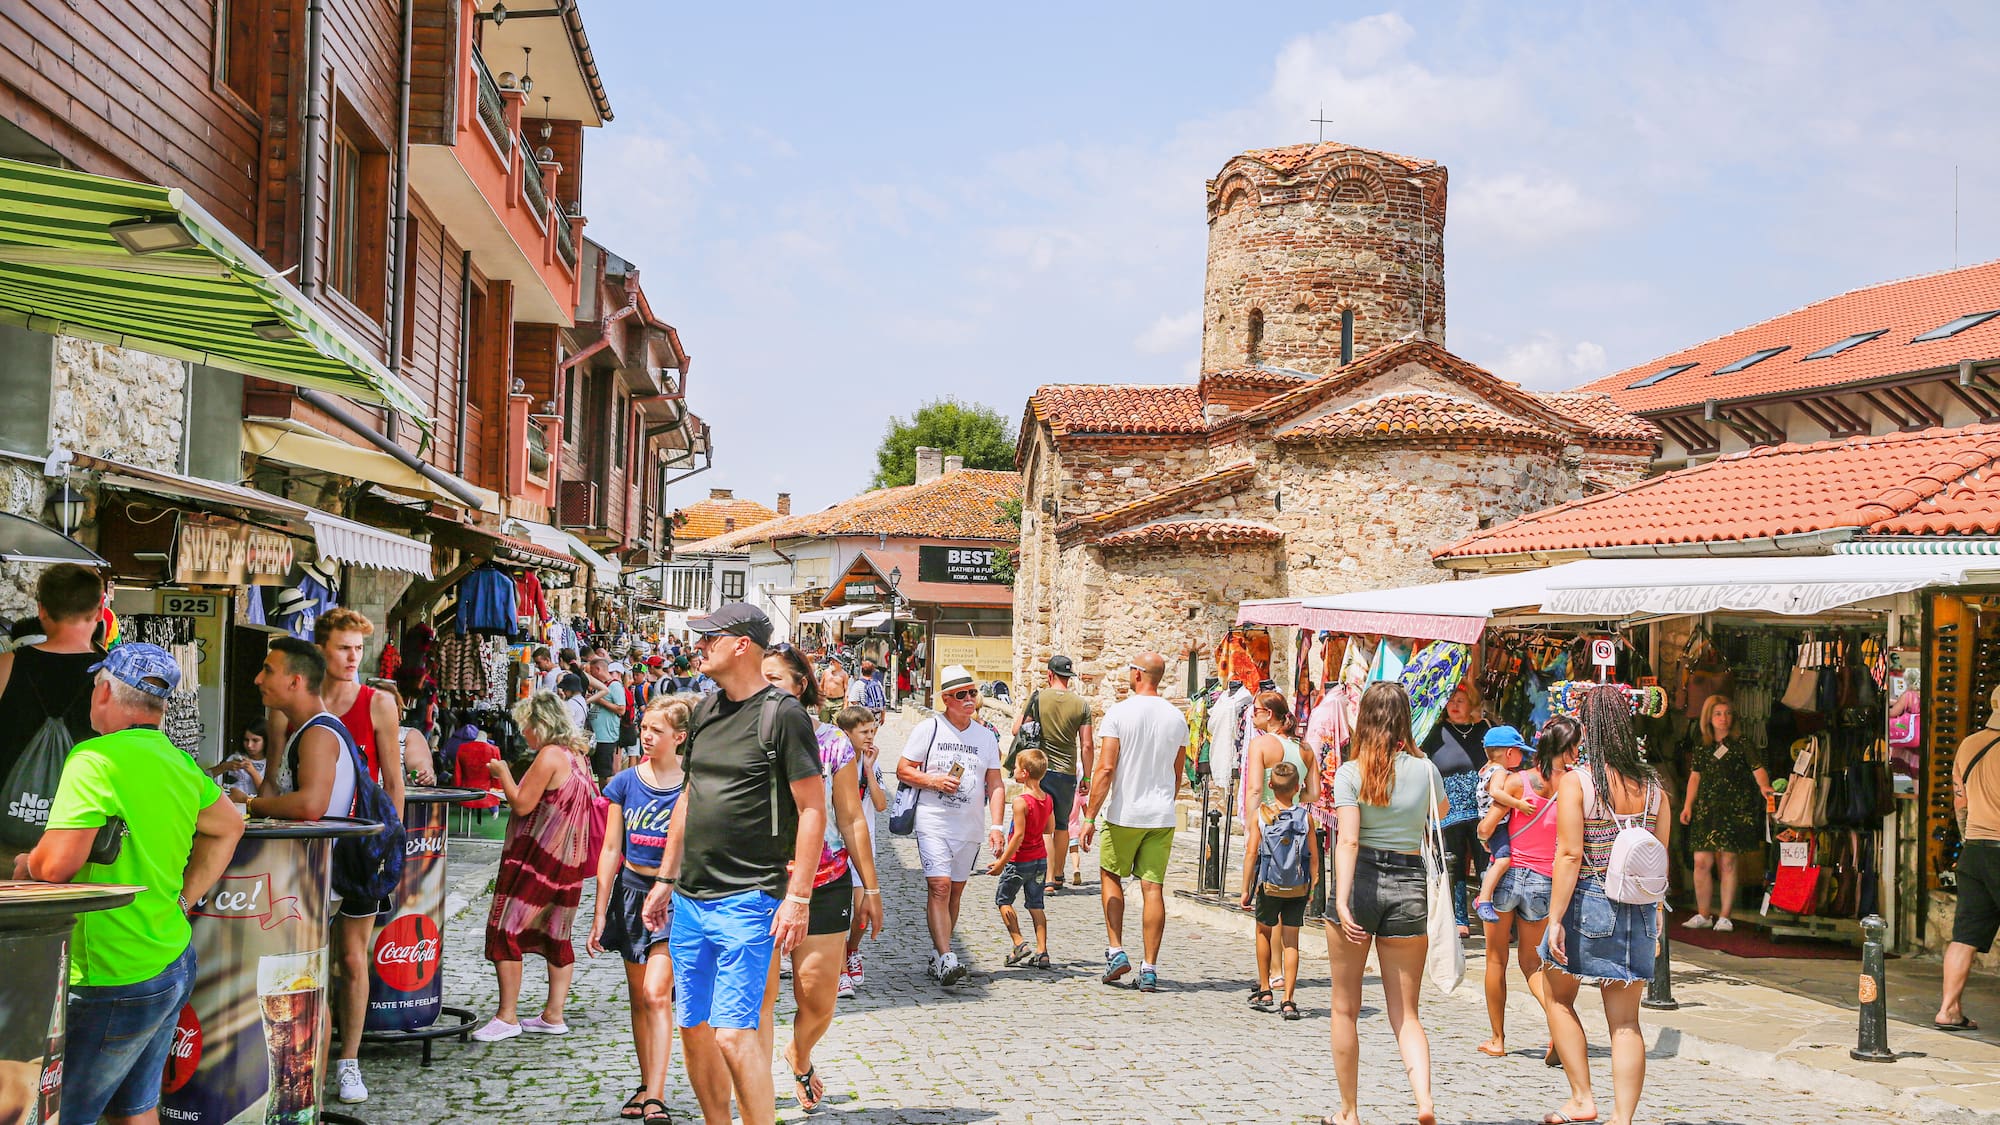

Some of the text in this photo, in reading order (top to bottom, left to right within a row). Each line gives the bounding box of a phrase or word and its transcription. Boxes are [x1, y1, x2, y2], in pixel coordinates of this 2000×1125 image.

[181, 525, 232, 572] SILVER
[247, 533, 293, 577] СЕРЕБРО
[948, 549, 994, 565] BEST
[947, 566, 975, 574] LEATHER
[170, 599, 209, 613] 925
[1551, 587, 1656, 613] SUNGLASSES
[1661, 584, 1771, 611] POLARIZED
[1422, 616, 1476, 642] PATRICIA
[937, 742, 979, 755] NORMANDIE
[377, 938, 439, 964] Coca-Cola
[371, 996, 439, 1009] TASTE THE FEELING
